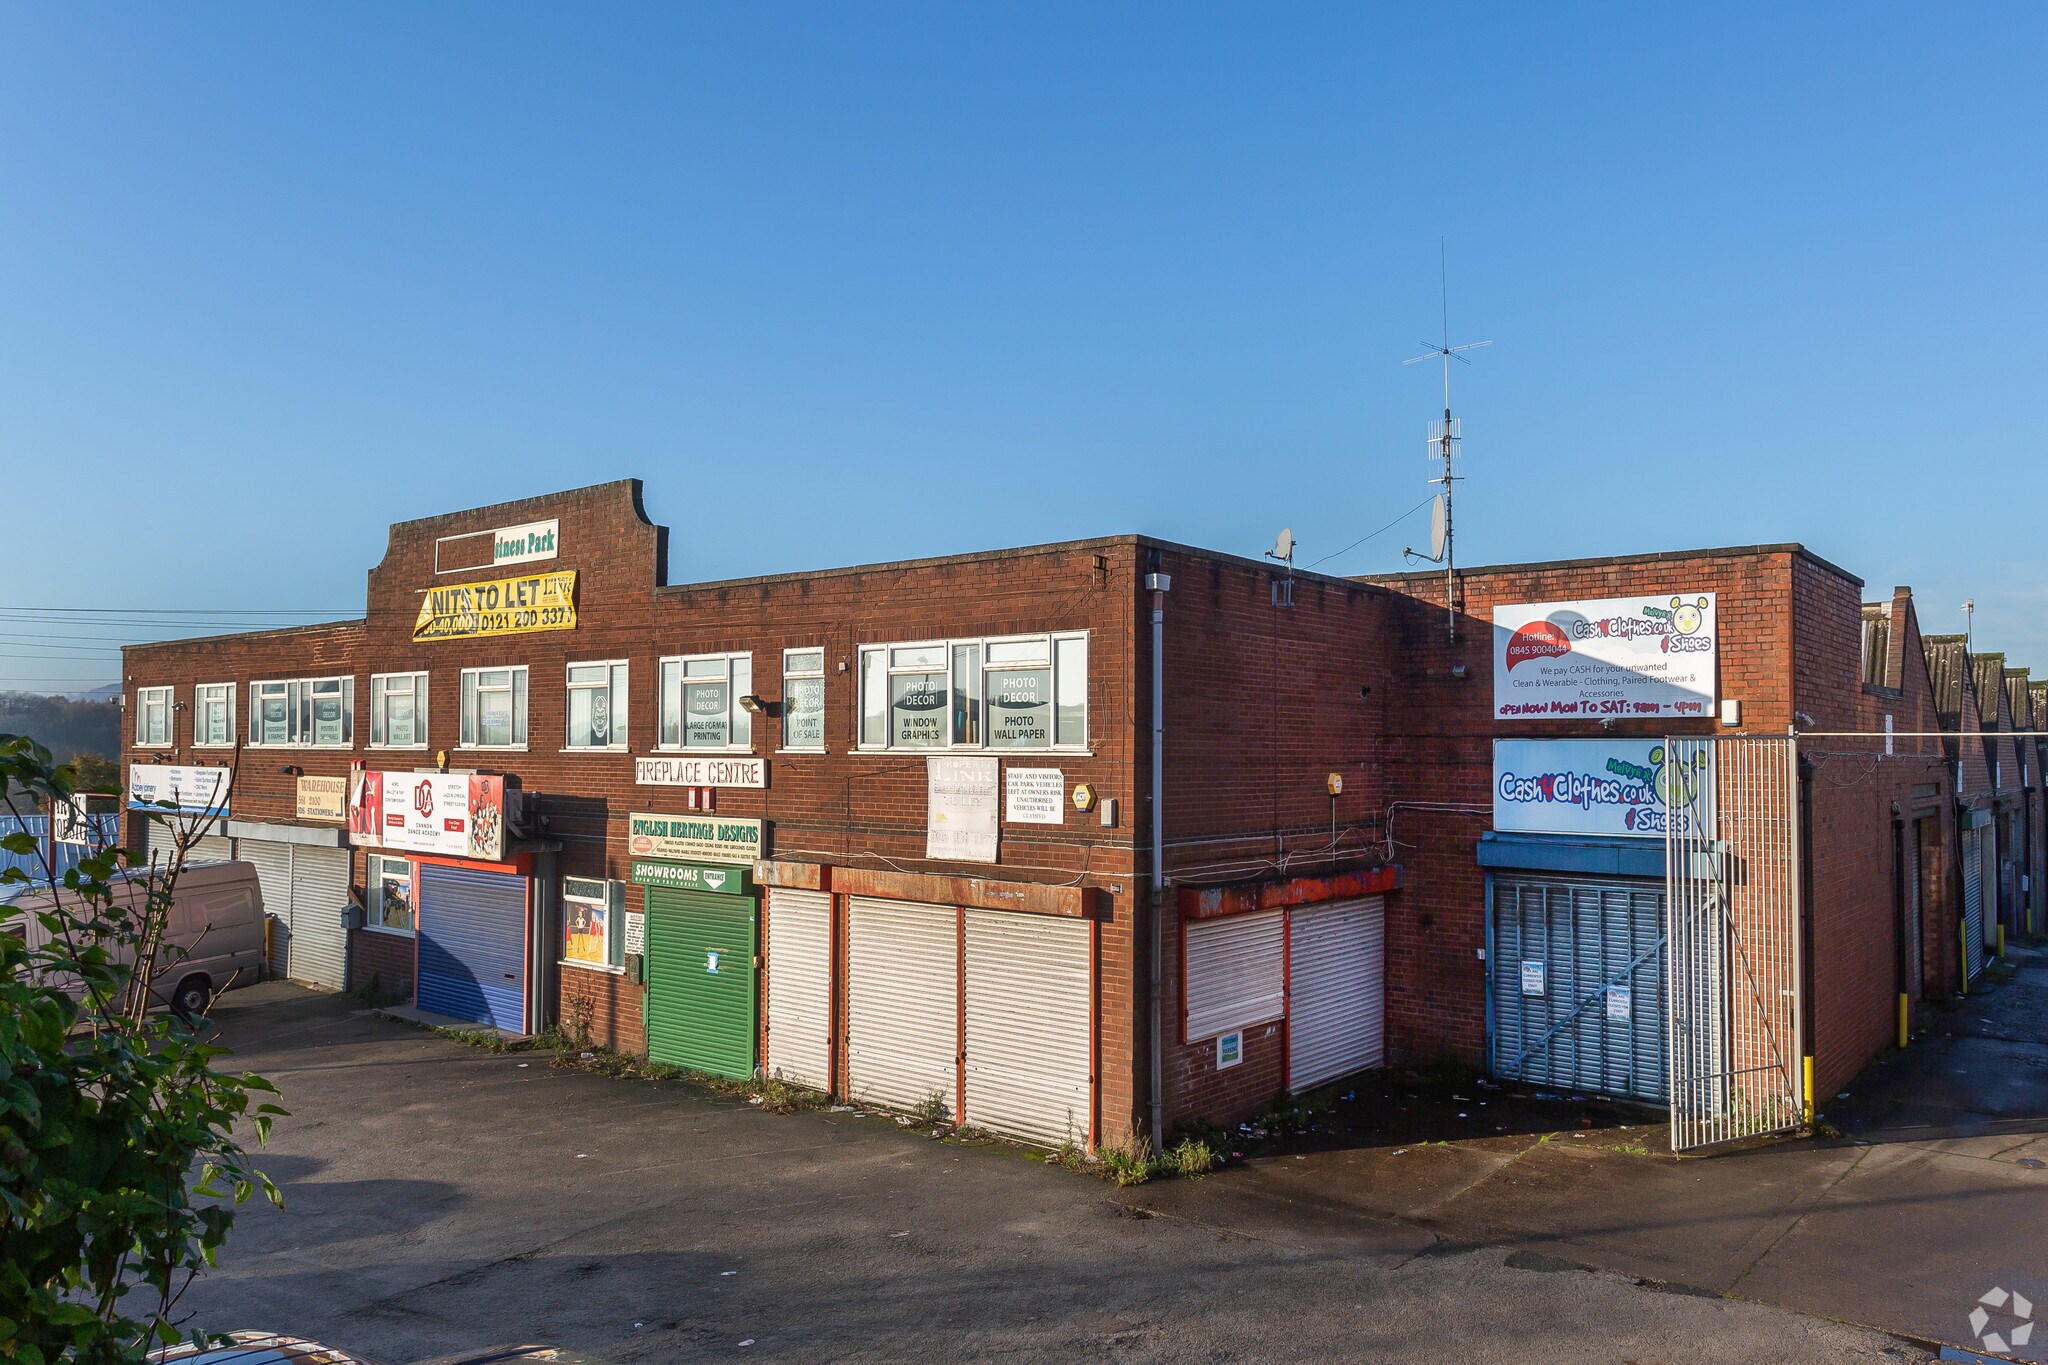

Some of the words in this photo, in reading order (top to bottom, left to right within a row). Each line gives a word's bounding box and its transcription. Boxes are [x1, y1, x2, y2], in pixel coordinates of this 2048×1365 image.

[528, 528, 555, 554] Park
[475, 584, 499, 611] TO
[505, 579, 541, 608] LET
[482, 614, 509, 631] 0121
[515, 610, 537, 627] 200
[1522, 632, 1554, 642] Hotline:
[1670, 634, 1711, 652] Shoes
[1510, 646, 1530, 654] 0845
[1531, 644, 1567, 654] 9004044
[1540, 667, 1552, 675] We
[1554, 668, 1568, 677] pay
[1570, 666, 1591, 674] CASH
[1592, 664, 1603, 673] for
[1604, 666, 1624, 675] your
[1626, 662, 1668, 672] unwanted
[1003, 678, 1036, 688] PHOTO
[1512, 679, 1534, 688] Clean
[1542, 678, 1578, 687] Wearable
[1584, 676, 1620, 688] Clothing,
[1622, 675, 1648, 684] Paired
[1650, 674, 1688, 684] Footwear
[1690, 674, 1696, 682] &
[906, 681, 936, 692] PHOTO
[696, 689, 718, 698] PHOTO
[1003, 692, 1036, 702] DECOR
[1579, 689, 1624, 698] Accessories
[696, 701, 718, 710] DECOR
[906, 695, 935, 706] DECOR
[1600, 700, 1631, 714] SAT:
[1674, 702, 1702, 715] 4pm
[686, 722, 704, 730] LARGE
[796, 718, 816, 728] POINT
[903, 718, 938, 727] WINDOW
[1004, 716, 1034, 726] PHOTO
[694, 732, 720, 740] PRINTING
[804, 730, 820, 739] SALE
[902, 730, 939, 740] GRAPHICS
[994, 730, 1016, 740] WALL
[1018, 729, 1045, 739] PAPER
[636, 761, 700, 782] FIREPLACE
[708, 762, 758, 784] CENTRE
[1607, 758, 1642, 780] Melvyn
[301, 780, 344, 793] WAREHOUSE
[307, 808, 334, 816] STATIONERS
[633, 820, 668, 837] ENGLISH
[670, 821, 714, 840] HERITAGE
[718, 824, 758, 843] DESIGNS
[636, 864, 698, 881] SHOWROOMS
[705, 872, 724, 881] ENTRANCE
